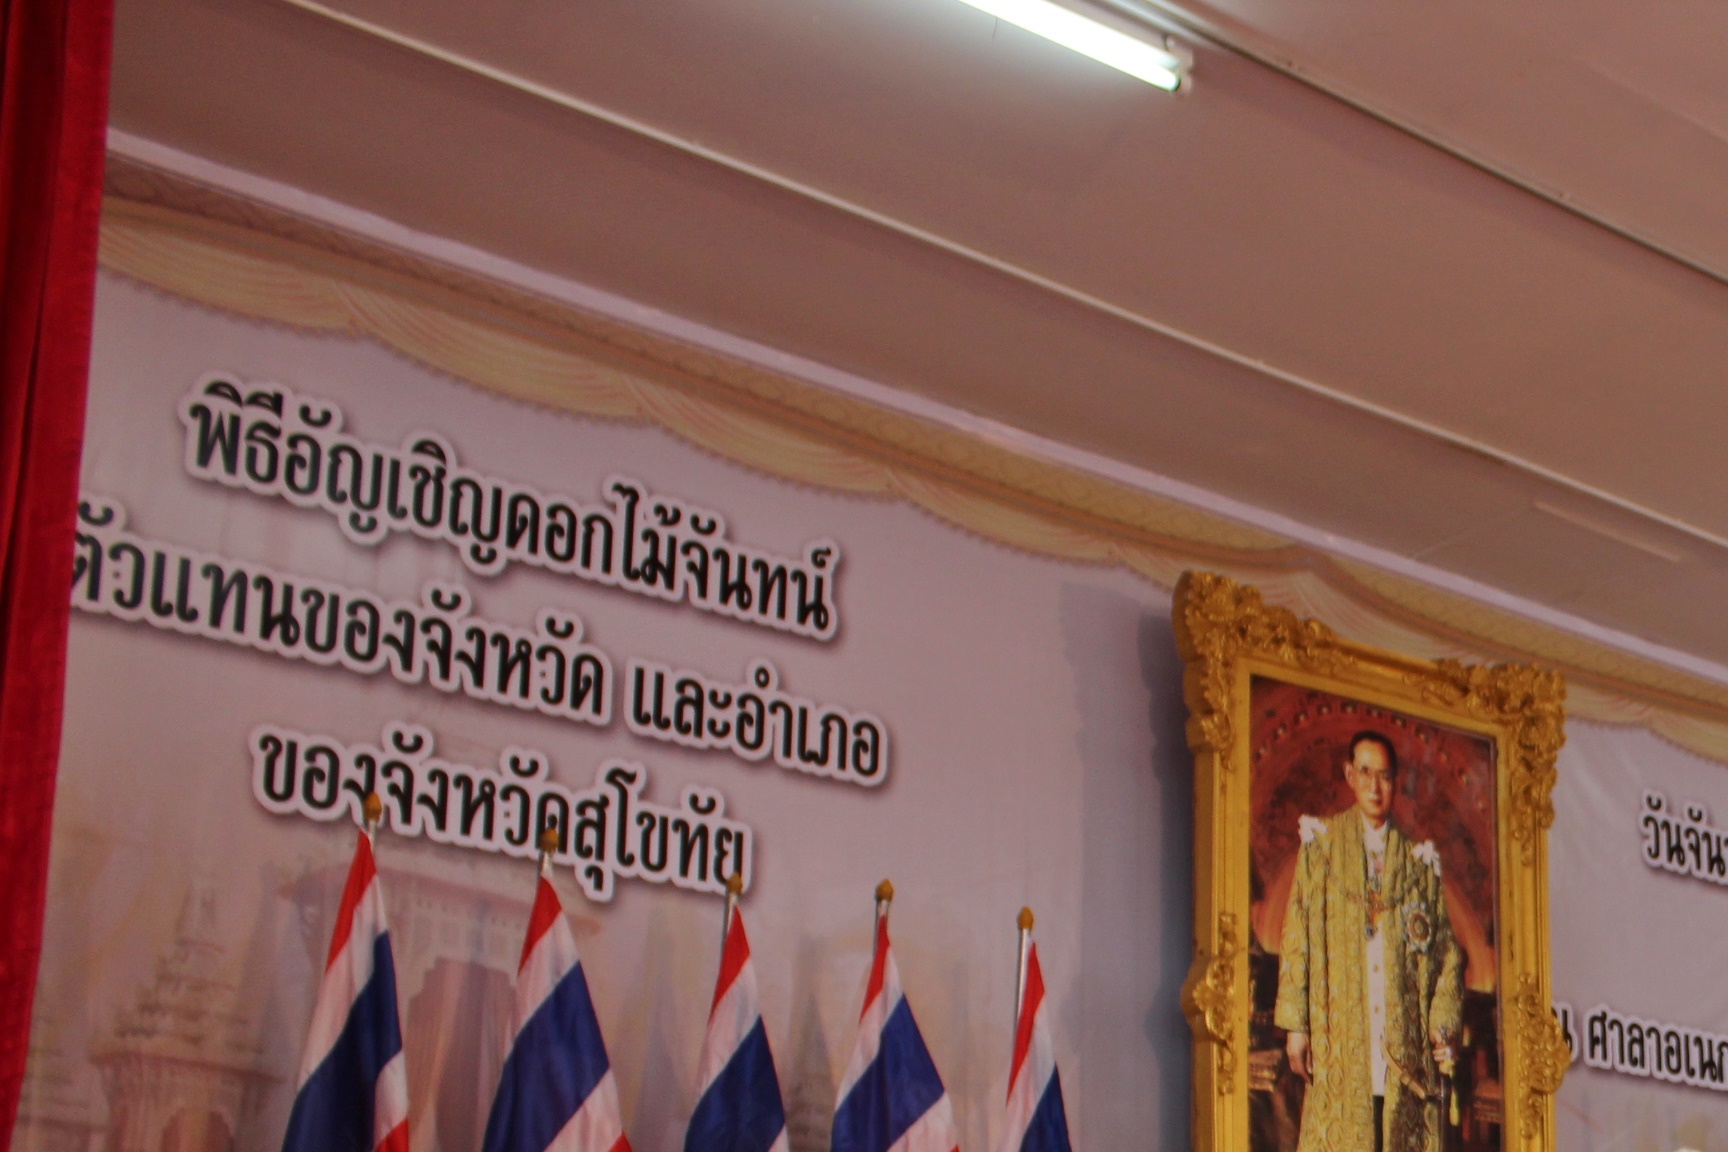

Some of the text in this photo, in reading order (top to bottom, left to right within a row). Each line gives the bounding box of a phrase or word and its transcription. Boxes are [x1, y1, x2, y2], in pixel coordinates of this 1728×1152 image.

[188, 380, 832, 631] พิธีอัญเชิญดอกไม้จันทน์
[631, 665, 880, 777] และอำเภอ
[258, 729, 745, 892] ของจังหวัดสุโขทัย
